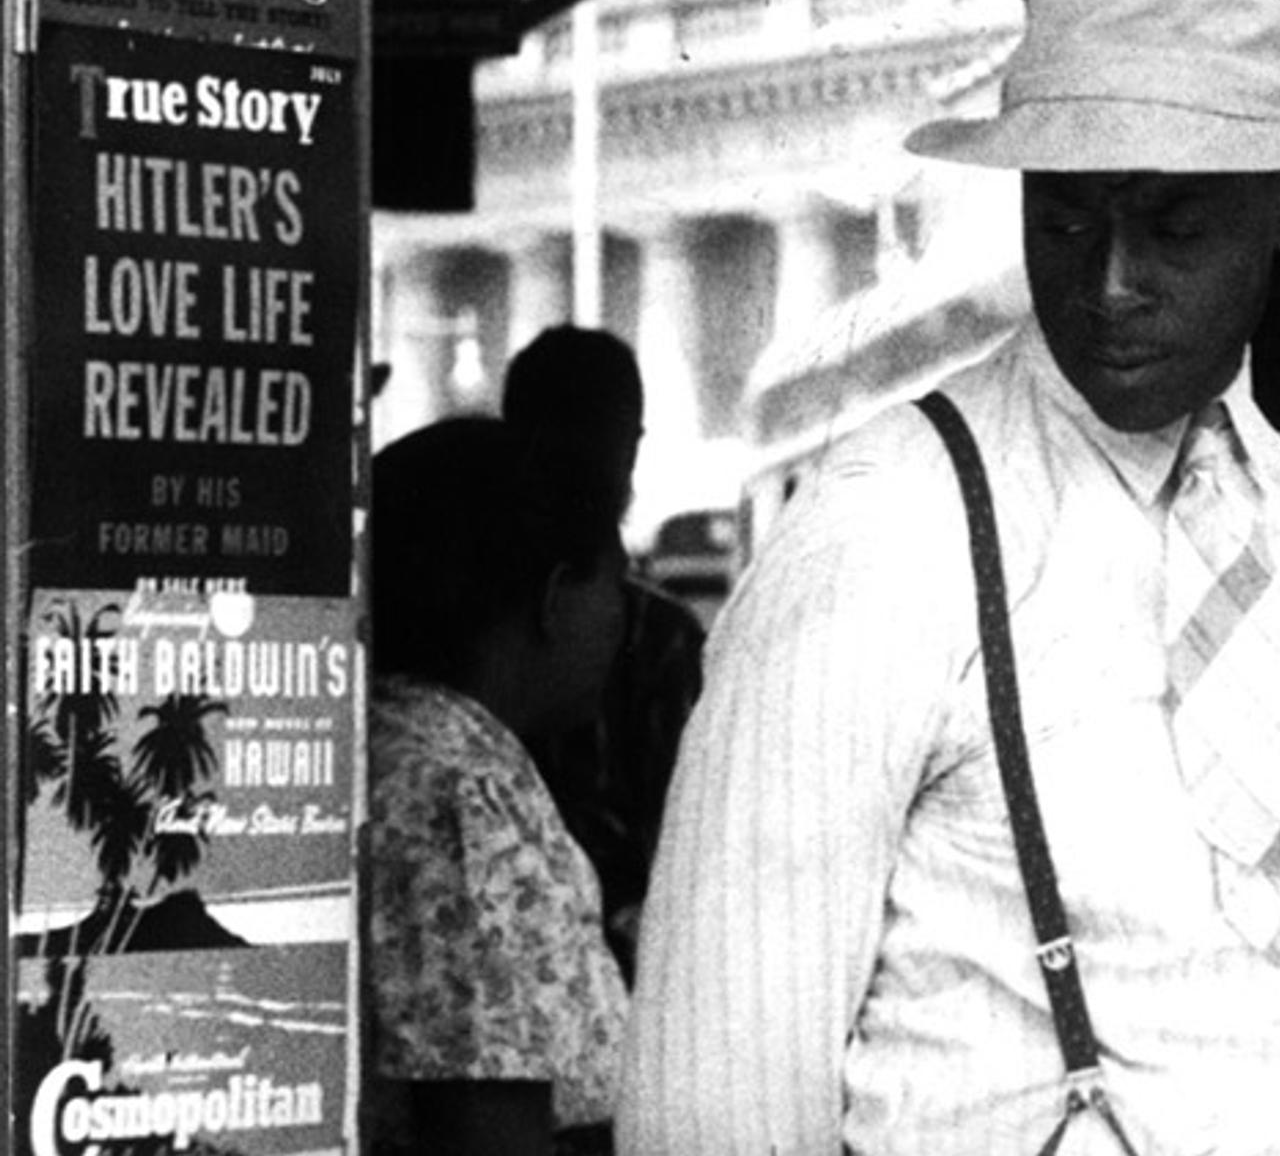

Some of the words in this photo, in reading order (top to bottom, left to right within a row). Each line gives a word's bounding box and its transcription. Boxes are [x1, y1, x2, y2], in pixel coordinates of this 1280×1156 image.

[70, 64, 187, 138] True
[197, 75, 322, 145] Story
[311, 65, 341, 85] JULY
[97, 153, 303, 245] HITLER'S
[84, 256, 200, 338] LOVE
[223, 265, 314, 346] LIFE
[83, 360, 311, 445] REVEALED
[152, 474, 185, 507] BY
[197, 477, 241, 509] HIS
[100, 522, 209, 555] FORMER
[221, 525, 288, 557] MAID
[35, 636, 139, 696] FAITH
[154, 636, 347, 697] BALDWIN'S
[225, 739, 333, 787] HAWAII
[30, 1060, 323, 1156] Cosmopolitan
